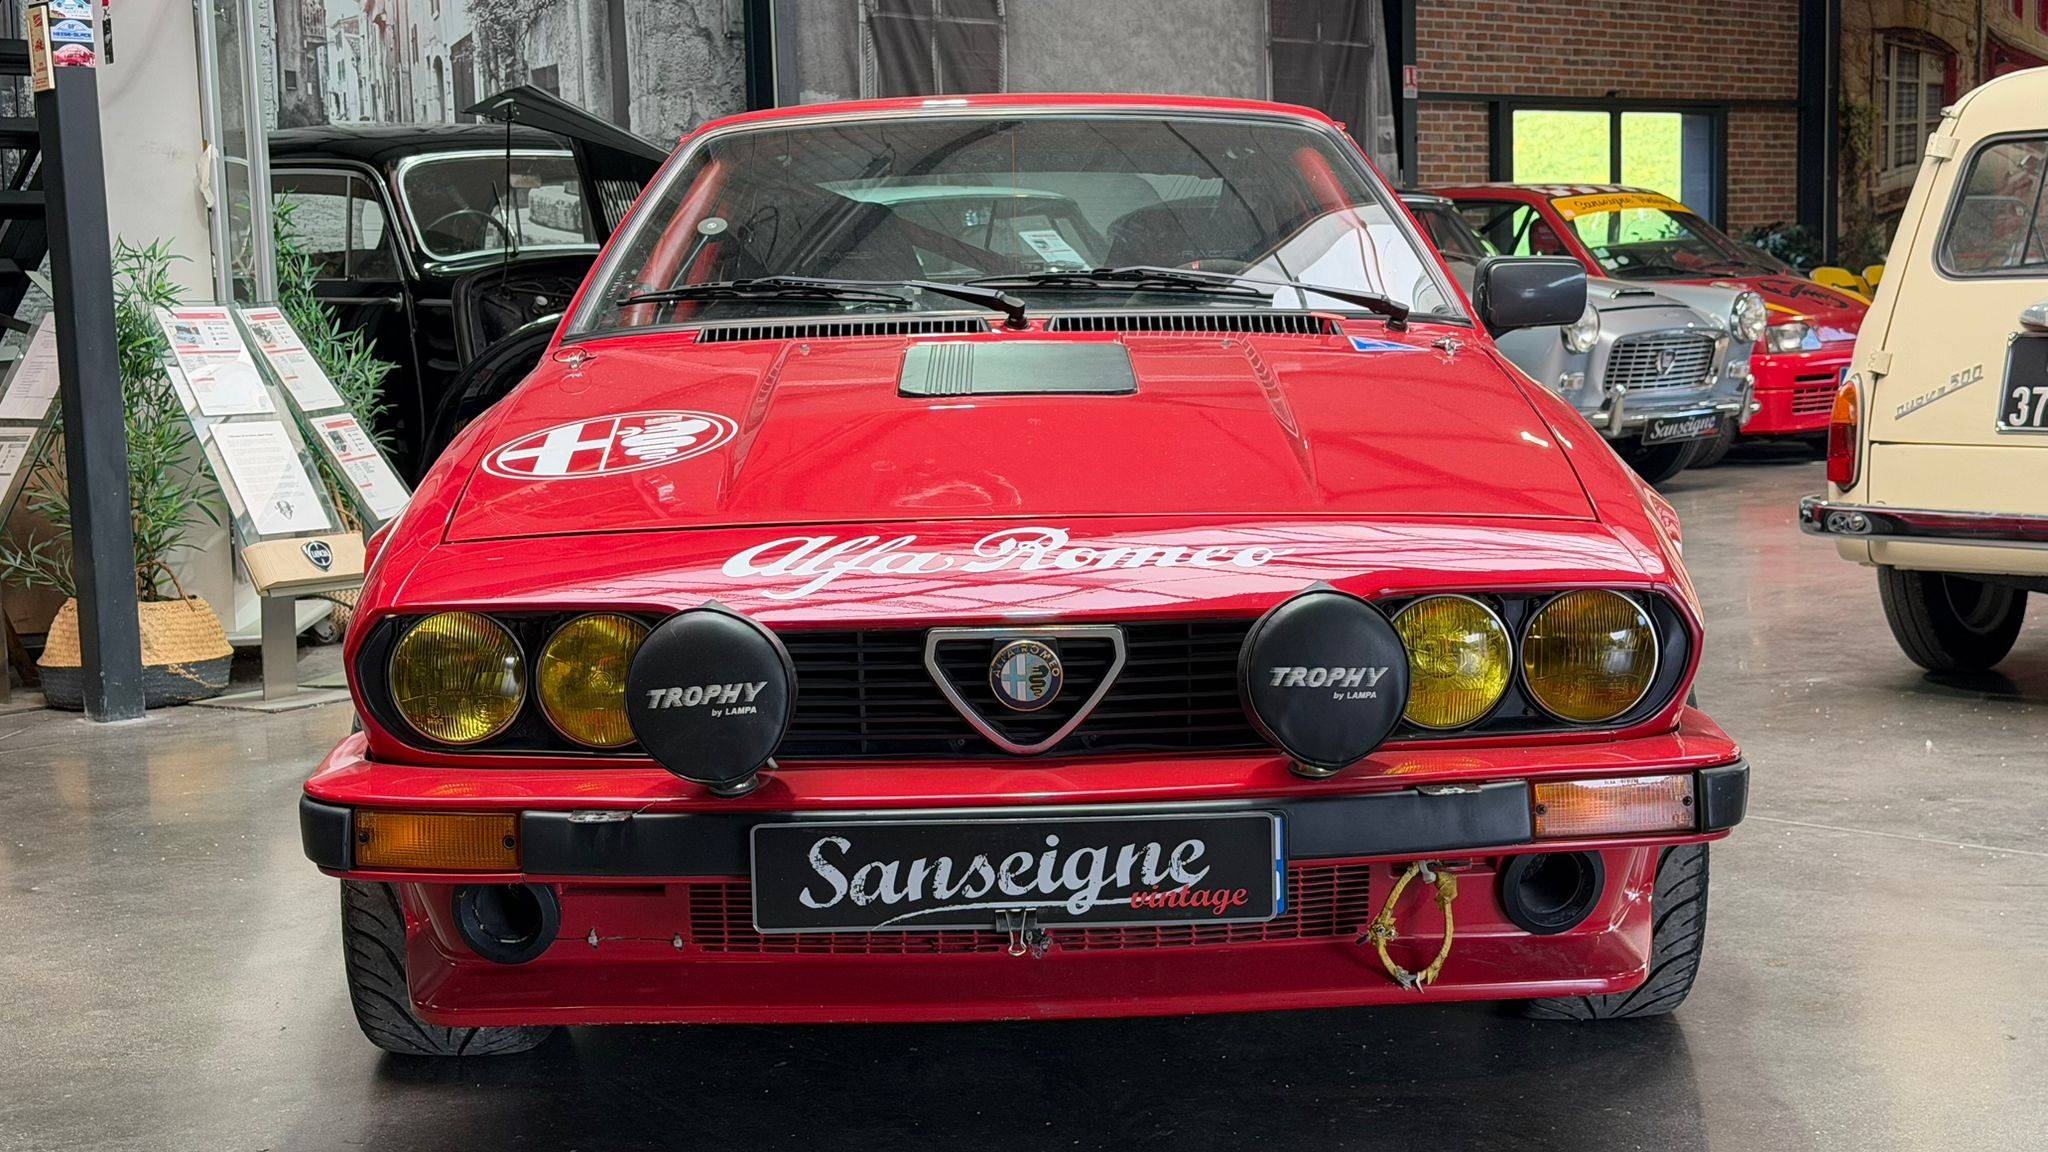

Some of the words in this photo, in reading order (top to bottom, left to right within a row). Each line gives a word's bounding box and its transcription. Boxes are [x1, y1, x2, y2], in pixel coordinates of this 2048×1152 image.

[1949, 364, 1984, 388] 500
[1650, 416, 1716, 439] Sanseigne
[721, 533, 954, 600] Alfa
[963, 526, 1297, 573] Romeo
[992, 649, 1016, 678] ALFA
[1020, 643, 1061, 678] ROMEO
[1269, 666, 1389, 688] TROPHY
[646, 681, 769, 709] TROPHY
[1333, 691, 1344, 700] by
[1347, 691, 1377, 699] LAMPA
[711, 708, 722, 718] by
[725, 706, 757, 715] LAMPA
[799, 834, 1211, 915] Sanseigne
[1129, 884, 1248, 915] vintage
